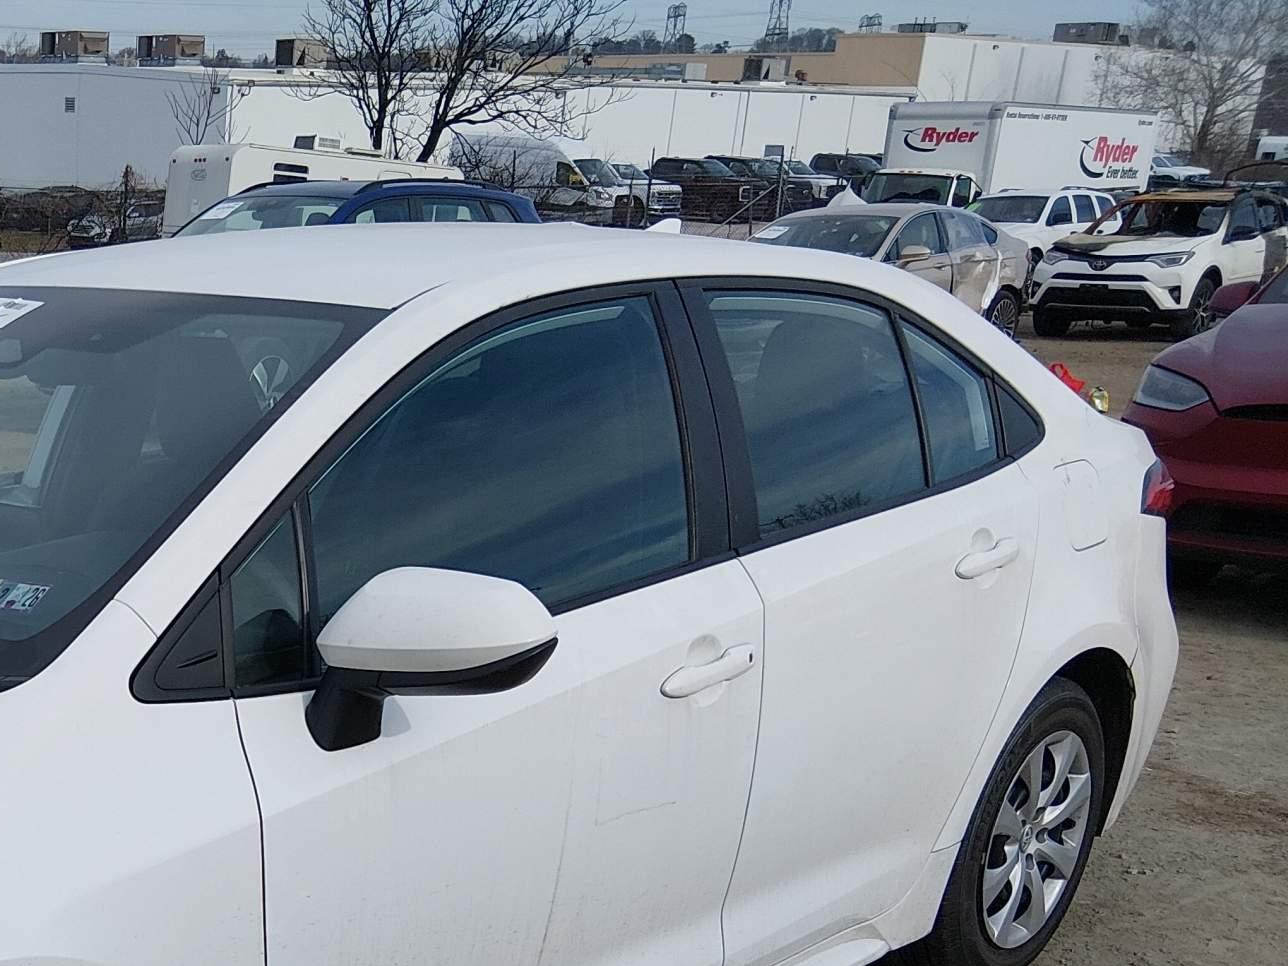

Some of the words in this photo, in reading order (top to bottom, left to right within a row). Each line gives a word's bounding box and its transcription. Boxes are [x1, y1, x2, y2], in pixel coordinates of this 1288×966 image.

[920, 127, 979, 146] Ryder
[1092, 136, 1138, 168] Ryder
[1106, 165, 1120, 178] Ever
[21, 587, 46, 607] 26
